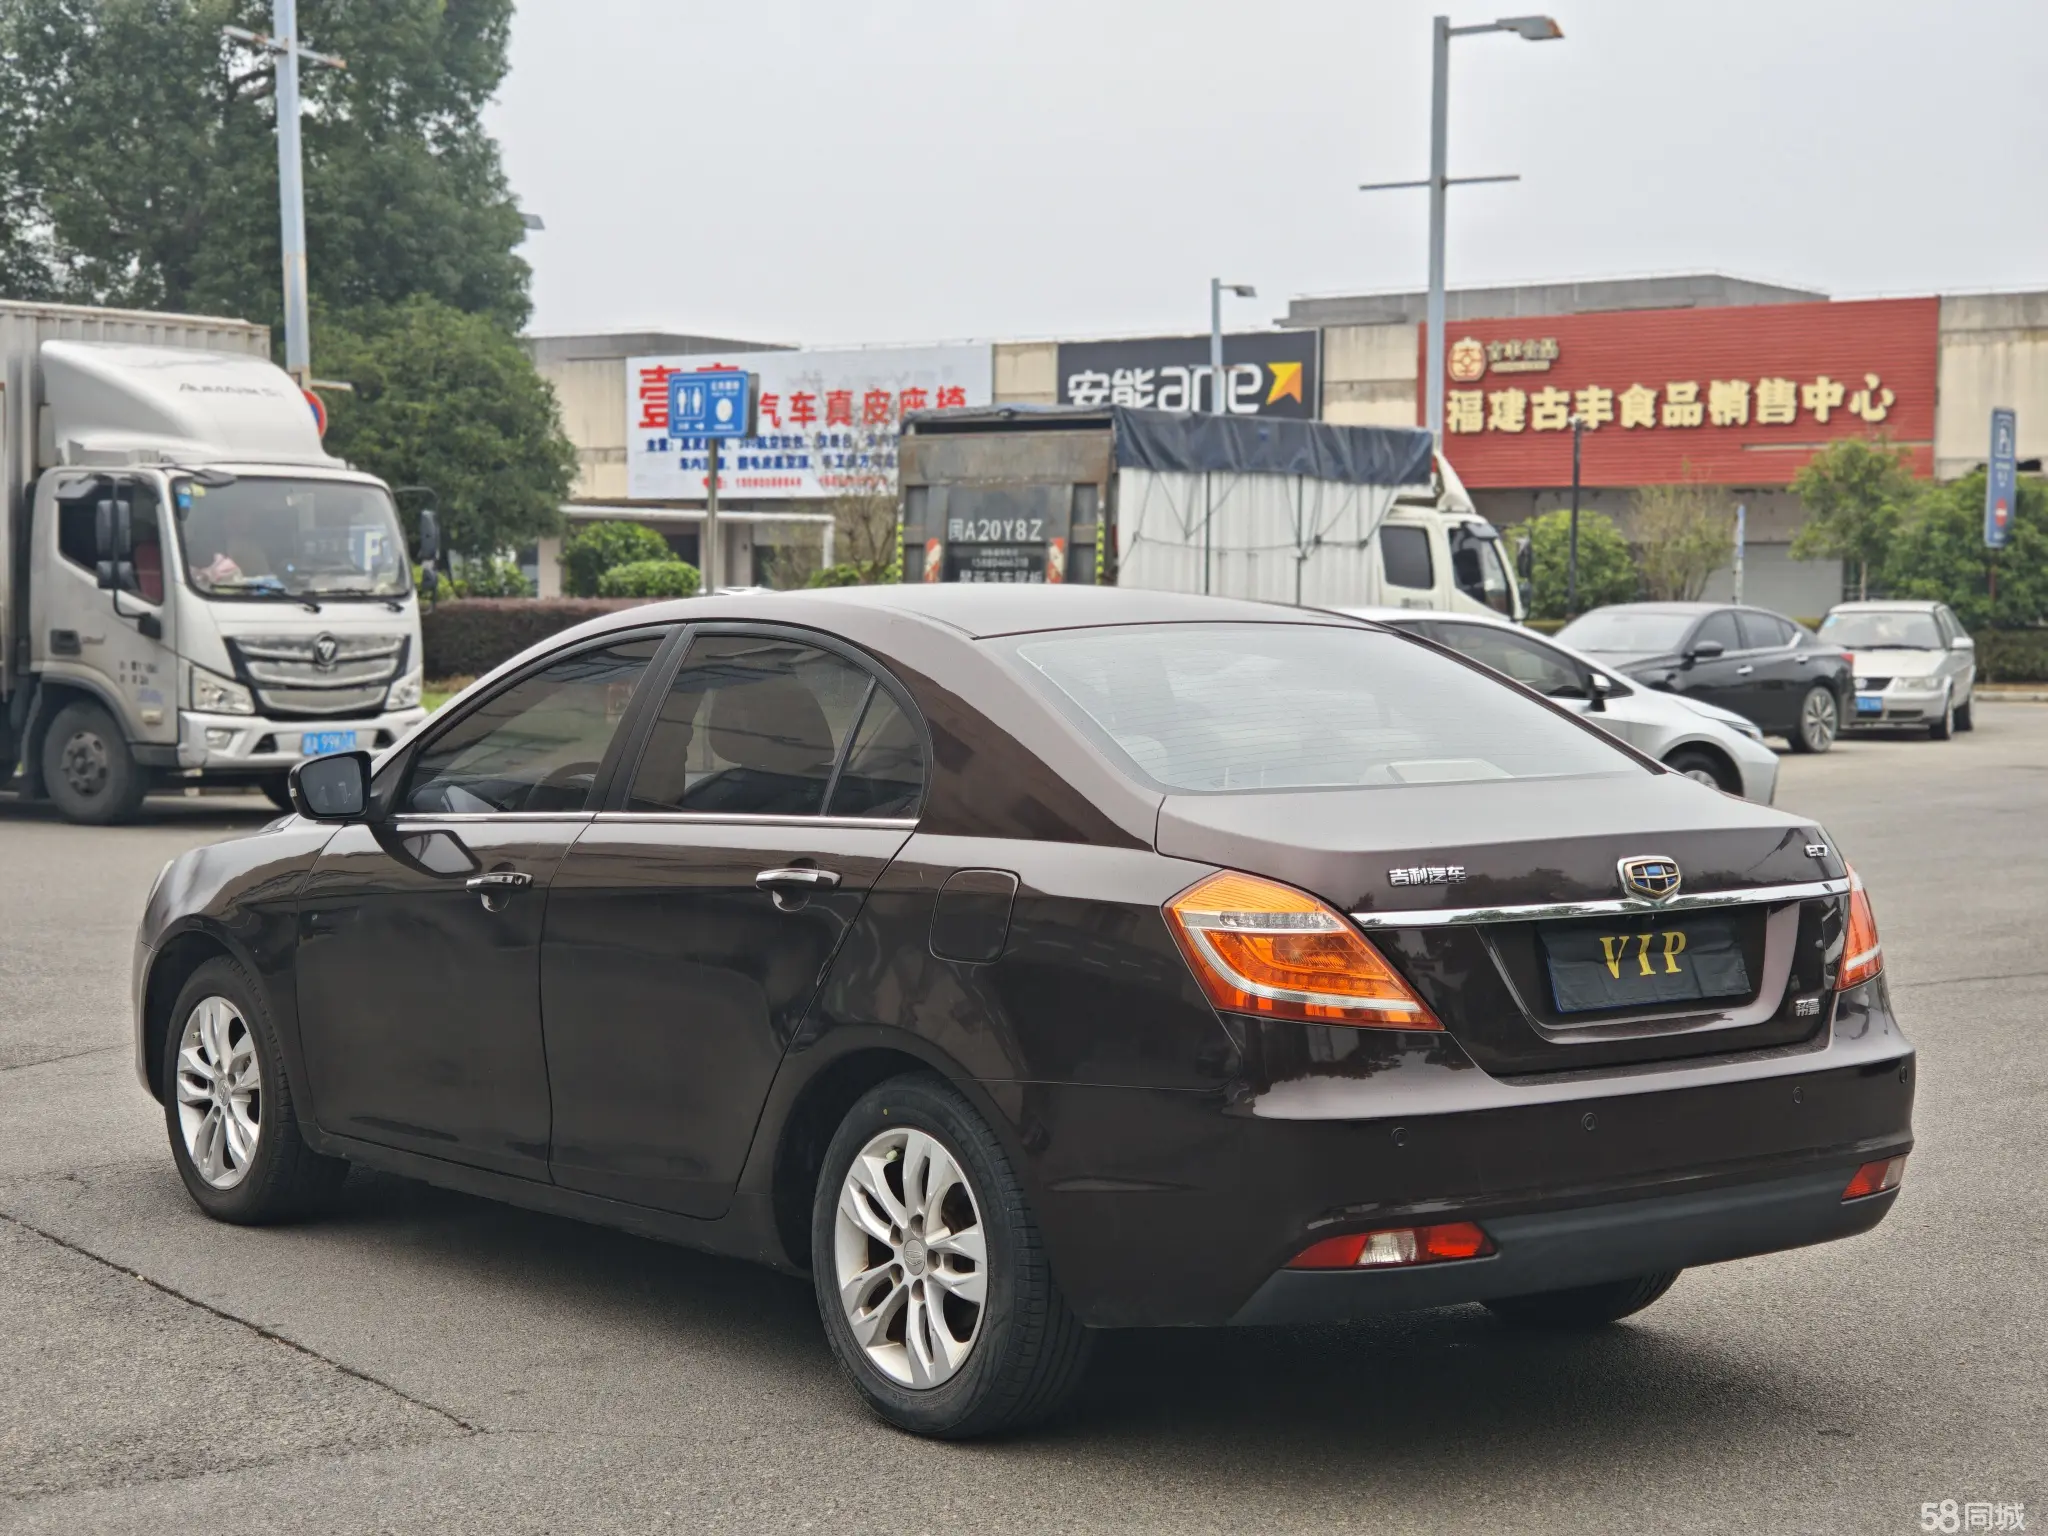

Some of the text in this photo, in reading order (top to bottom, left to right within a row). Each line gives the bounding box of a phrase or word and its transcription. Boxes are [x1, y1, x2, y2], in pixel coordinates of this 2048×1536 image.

[1389, 866, 1466, 886] 吉利汽车
[1600, 932, 1688, 980] VIP
